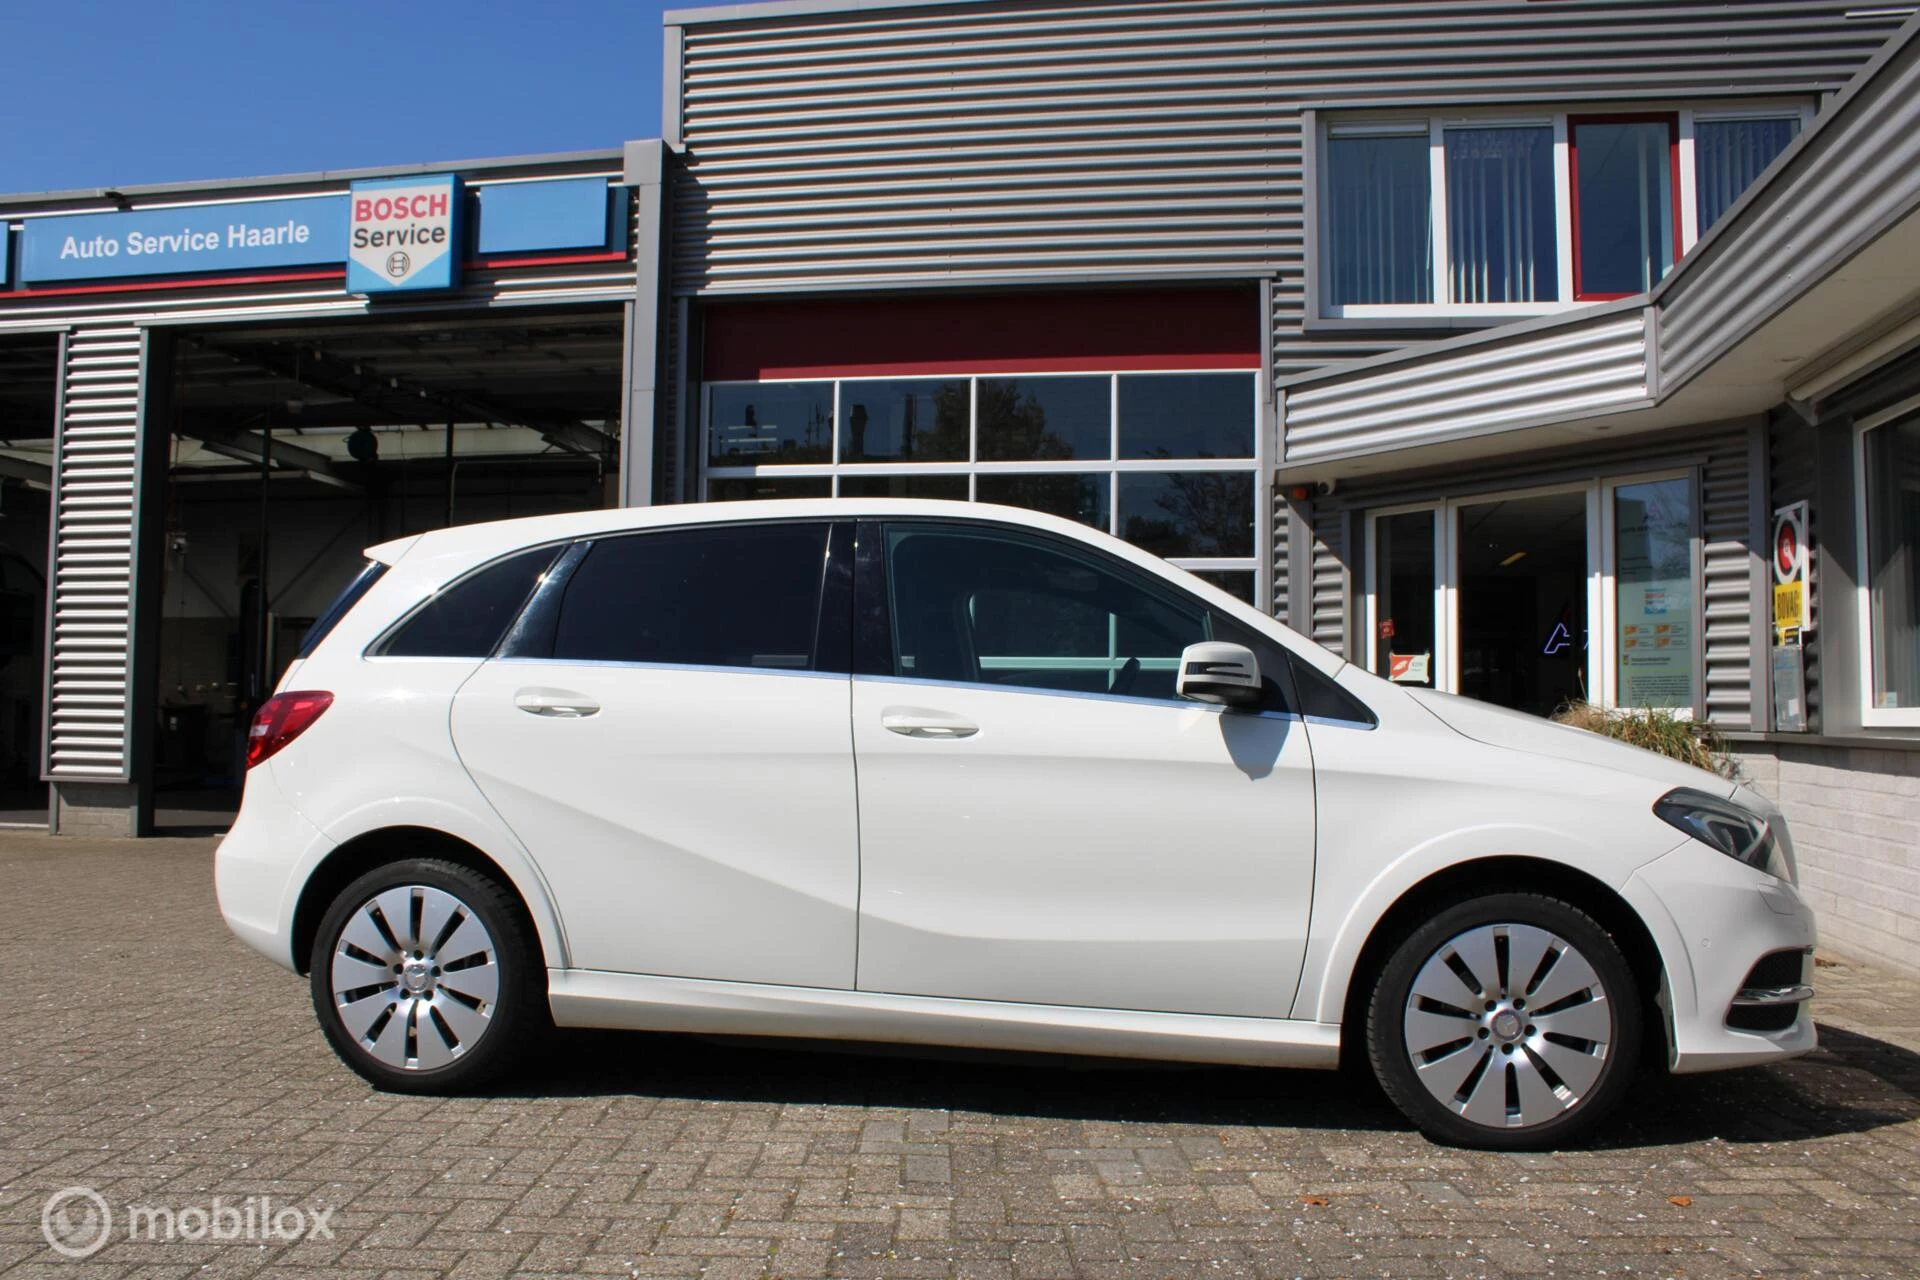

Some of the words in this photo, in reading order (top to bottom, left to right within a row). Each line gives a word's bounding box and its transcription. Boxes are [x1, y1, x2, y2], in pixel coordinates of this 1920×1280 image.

[355, 193, 448, 222] BOSCH
[60, 236, 119, 260] Auto
[127, 228, 220, 256] Service
[227, 220, 310, 248] Haarle
[353, 223, 446, 249] Service
